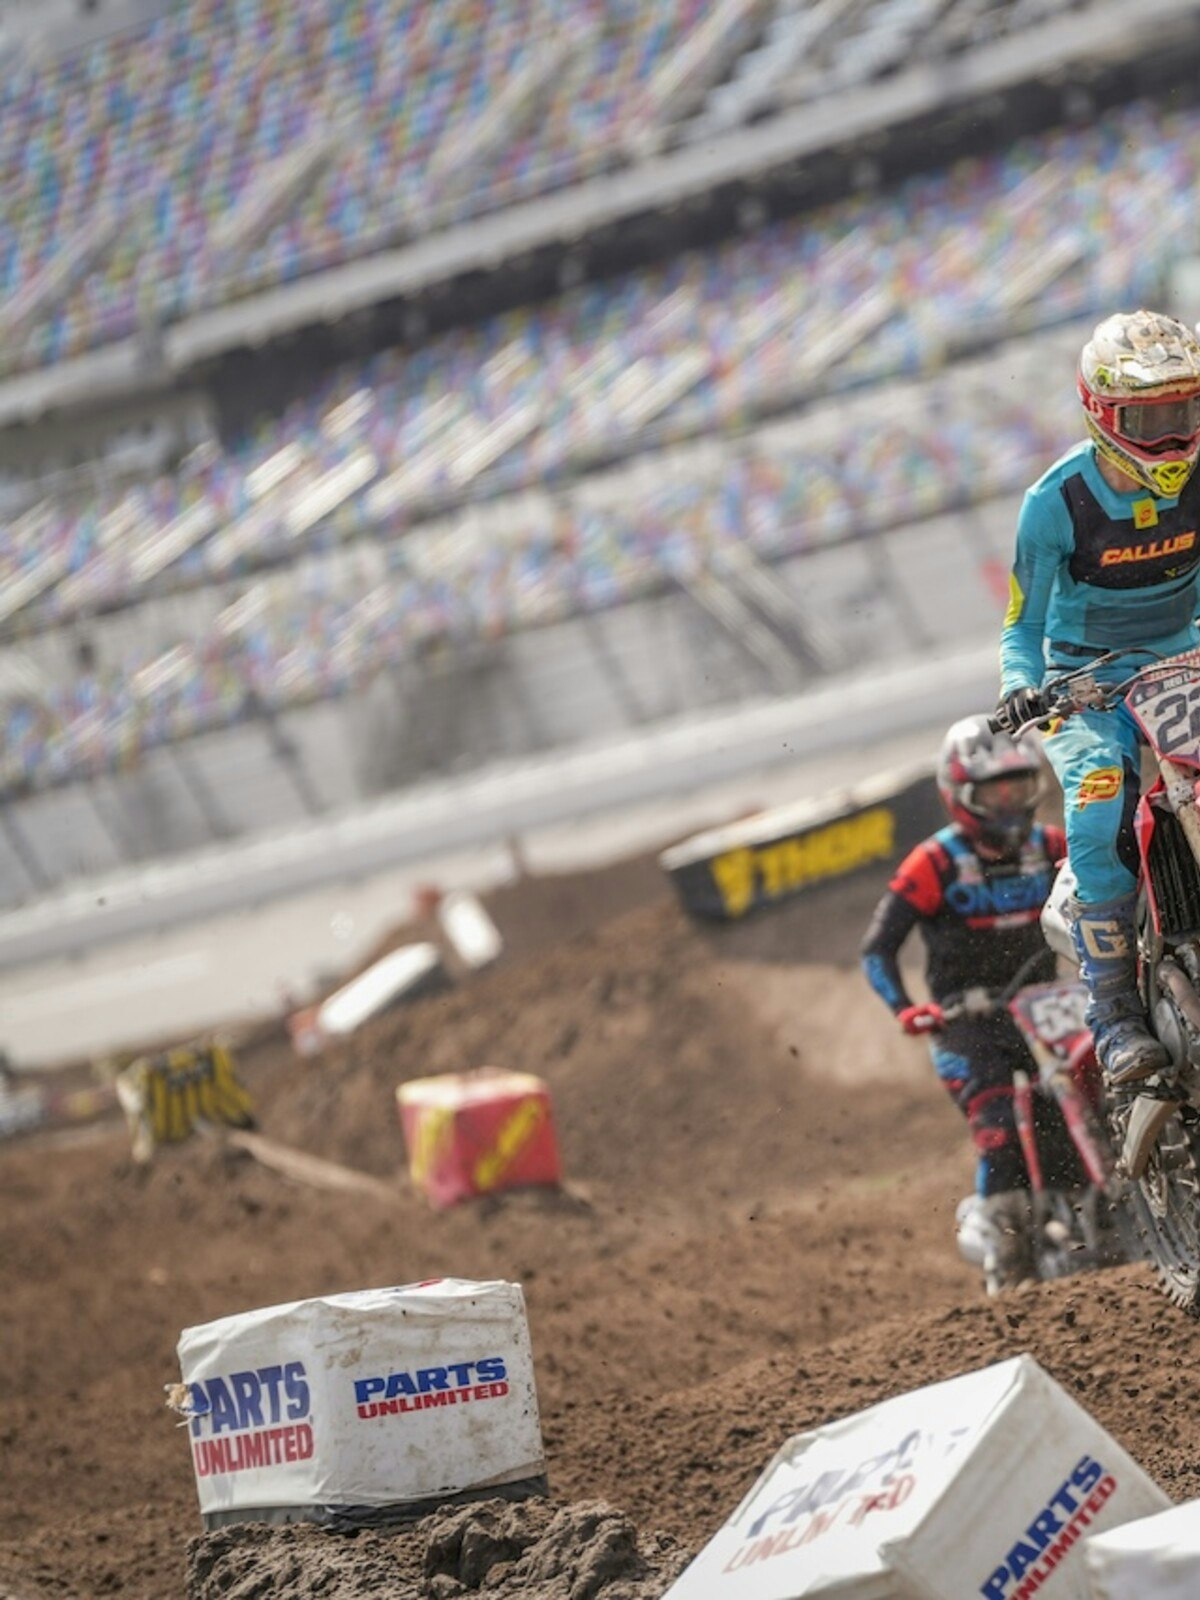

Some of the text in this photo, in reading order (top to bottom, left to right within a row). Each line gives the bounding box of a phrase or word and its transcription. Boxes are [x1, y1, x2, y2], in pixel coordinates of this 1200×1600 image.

[1100, 530, 1196, 567] CALLUS
[189, 1361, 313, 1438] PARTS
[354, 1357, 508, 1404] PARTS
[357, 1381, 510, 1420] UNLIMITED
[194, 1423, 315, 1477] UNLIMITED
[720, 1474, 917, 1575] UNLIMTED
[979, 1454, 1104, 1600] PARTS
[1010, 1475, 1118, 1600] NLIMITED
